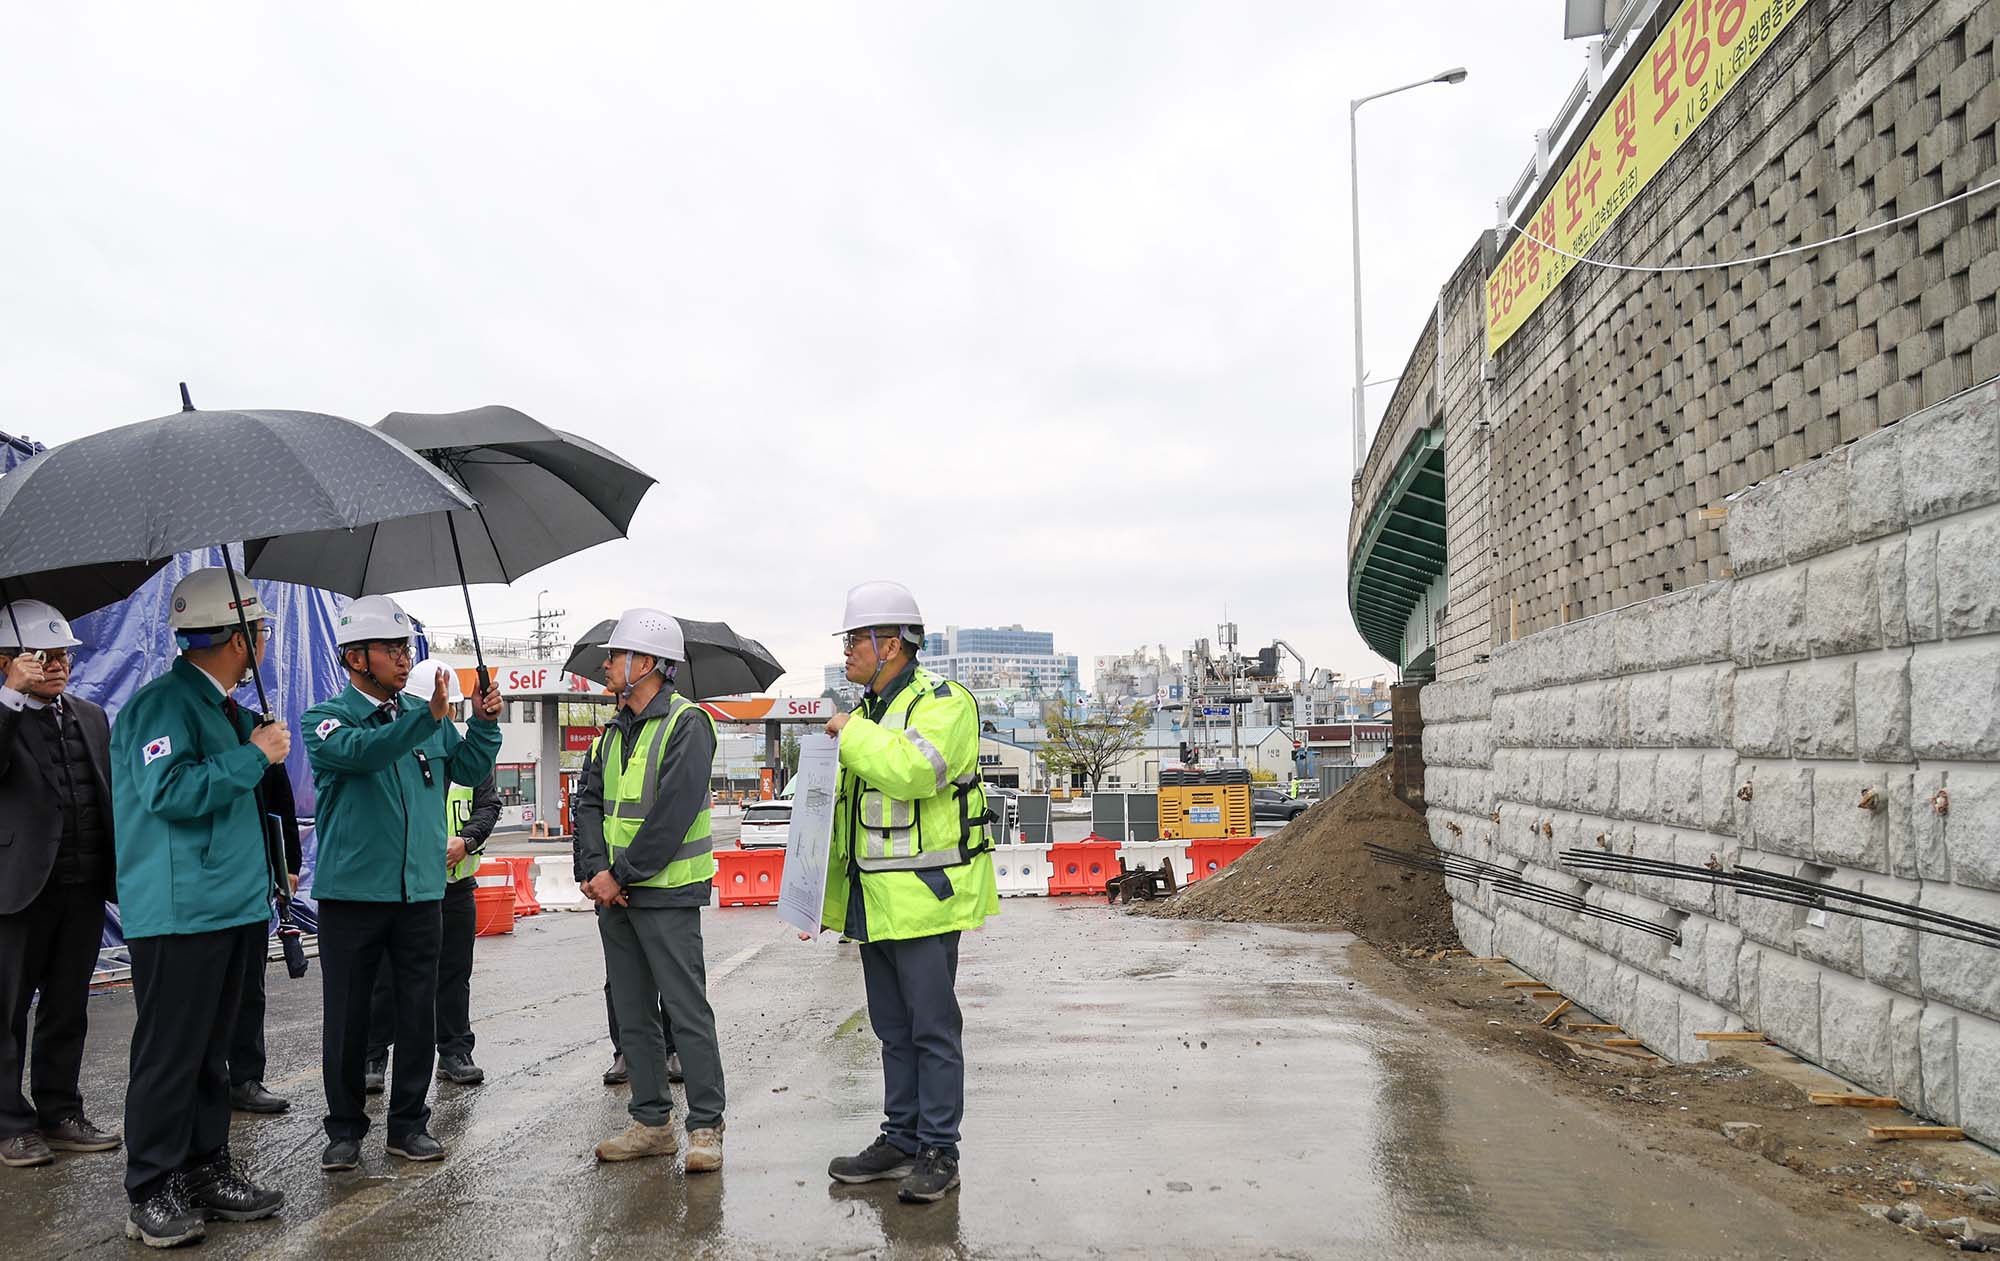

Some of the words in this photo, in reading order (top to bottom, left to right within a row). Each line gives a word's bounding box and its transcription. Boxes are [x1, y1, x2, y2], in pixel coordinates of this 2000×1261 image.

[1490, 194, 1556, 328] 보강토옹벽
[1565, 140, 1602, 235] 보수
[1615, 82, 1637, 176] 및
[509, 670, 547, 690] Self
[788, 701, 821, 714] Self
